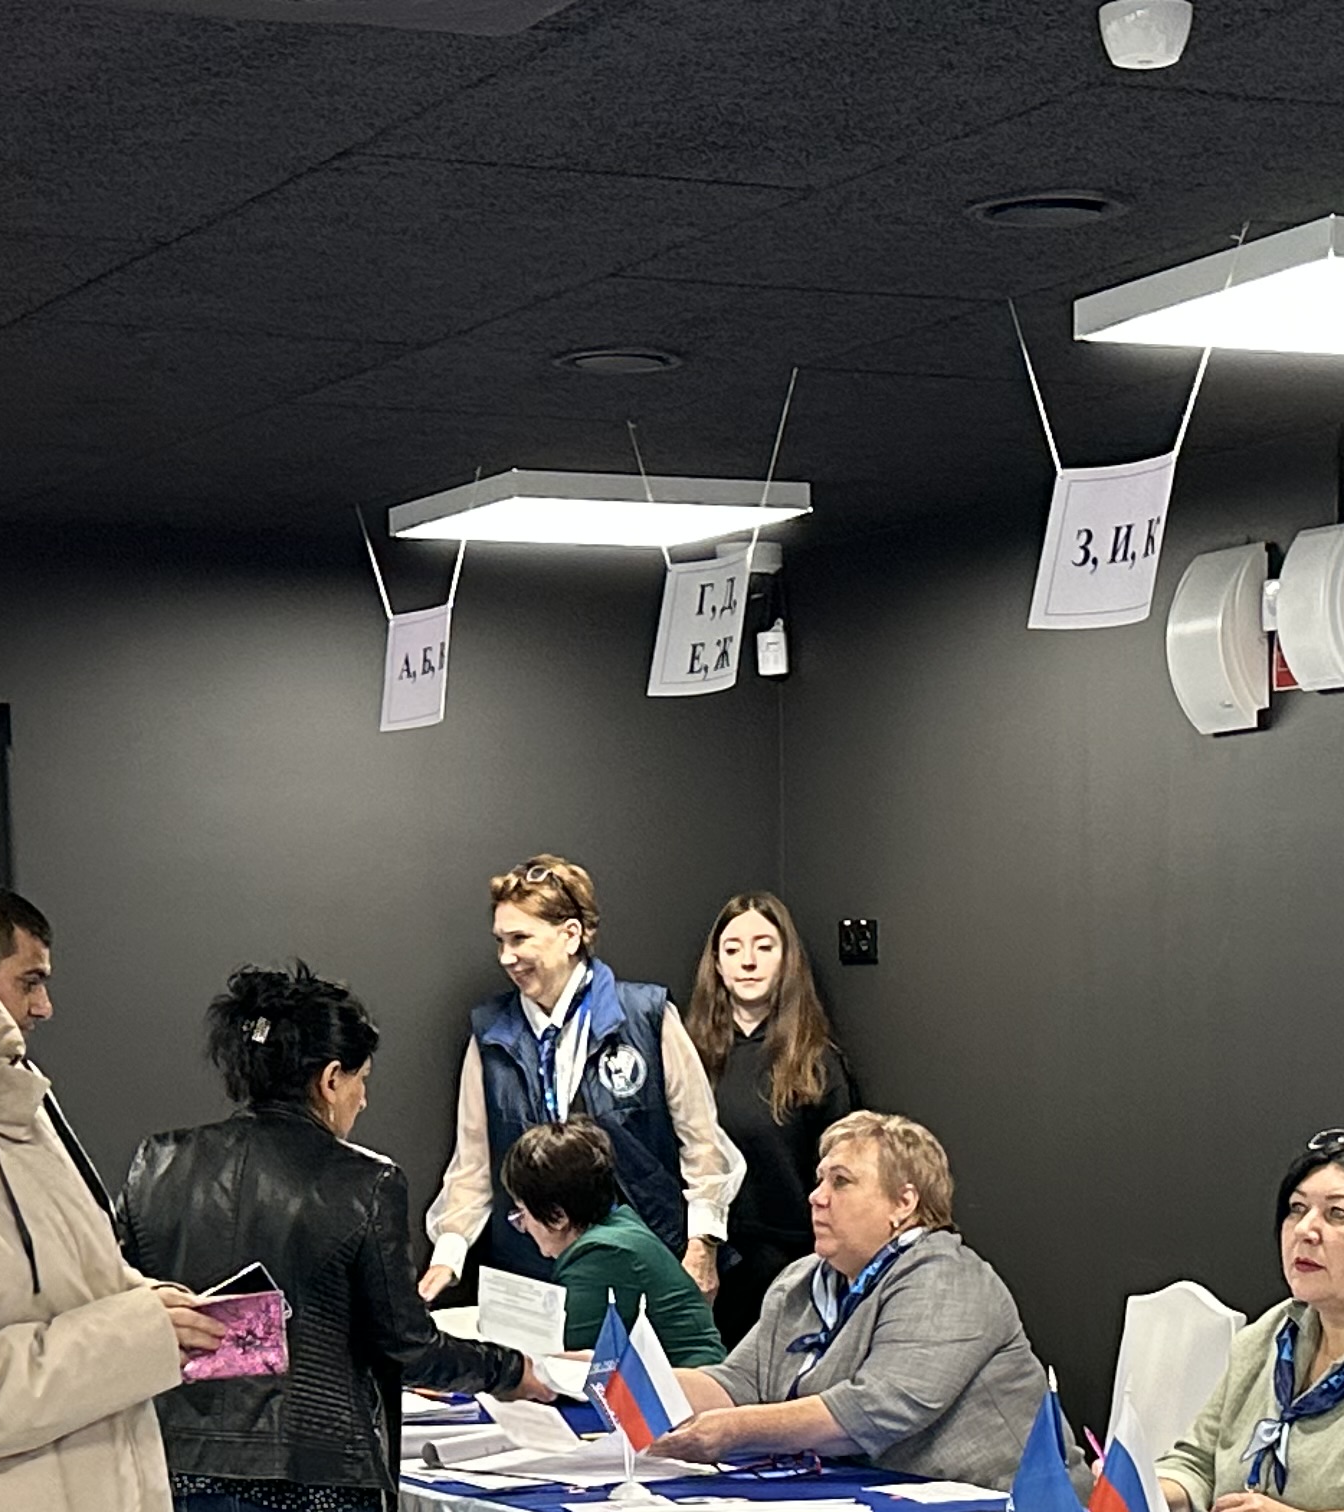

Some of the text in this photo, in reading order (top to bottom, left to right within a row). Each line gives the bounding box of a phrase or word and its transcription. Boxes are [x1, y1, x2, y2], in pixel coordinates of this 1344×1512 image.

[1071, 515, 1161, 575] З, И, К
[695, 576, 738, 621] Г, Д,
[398, 652, 417, 684] А,
[686, 634, 734, 681] Е, Ж
